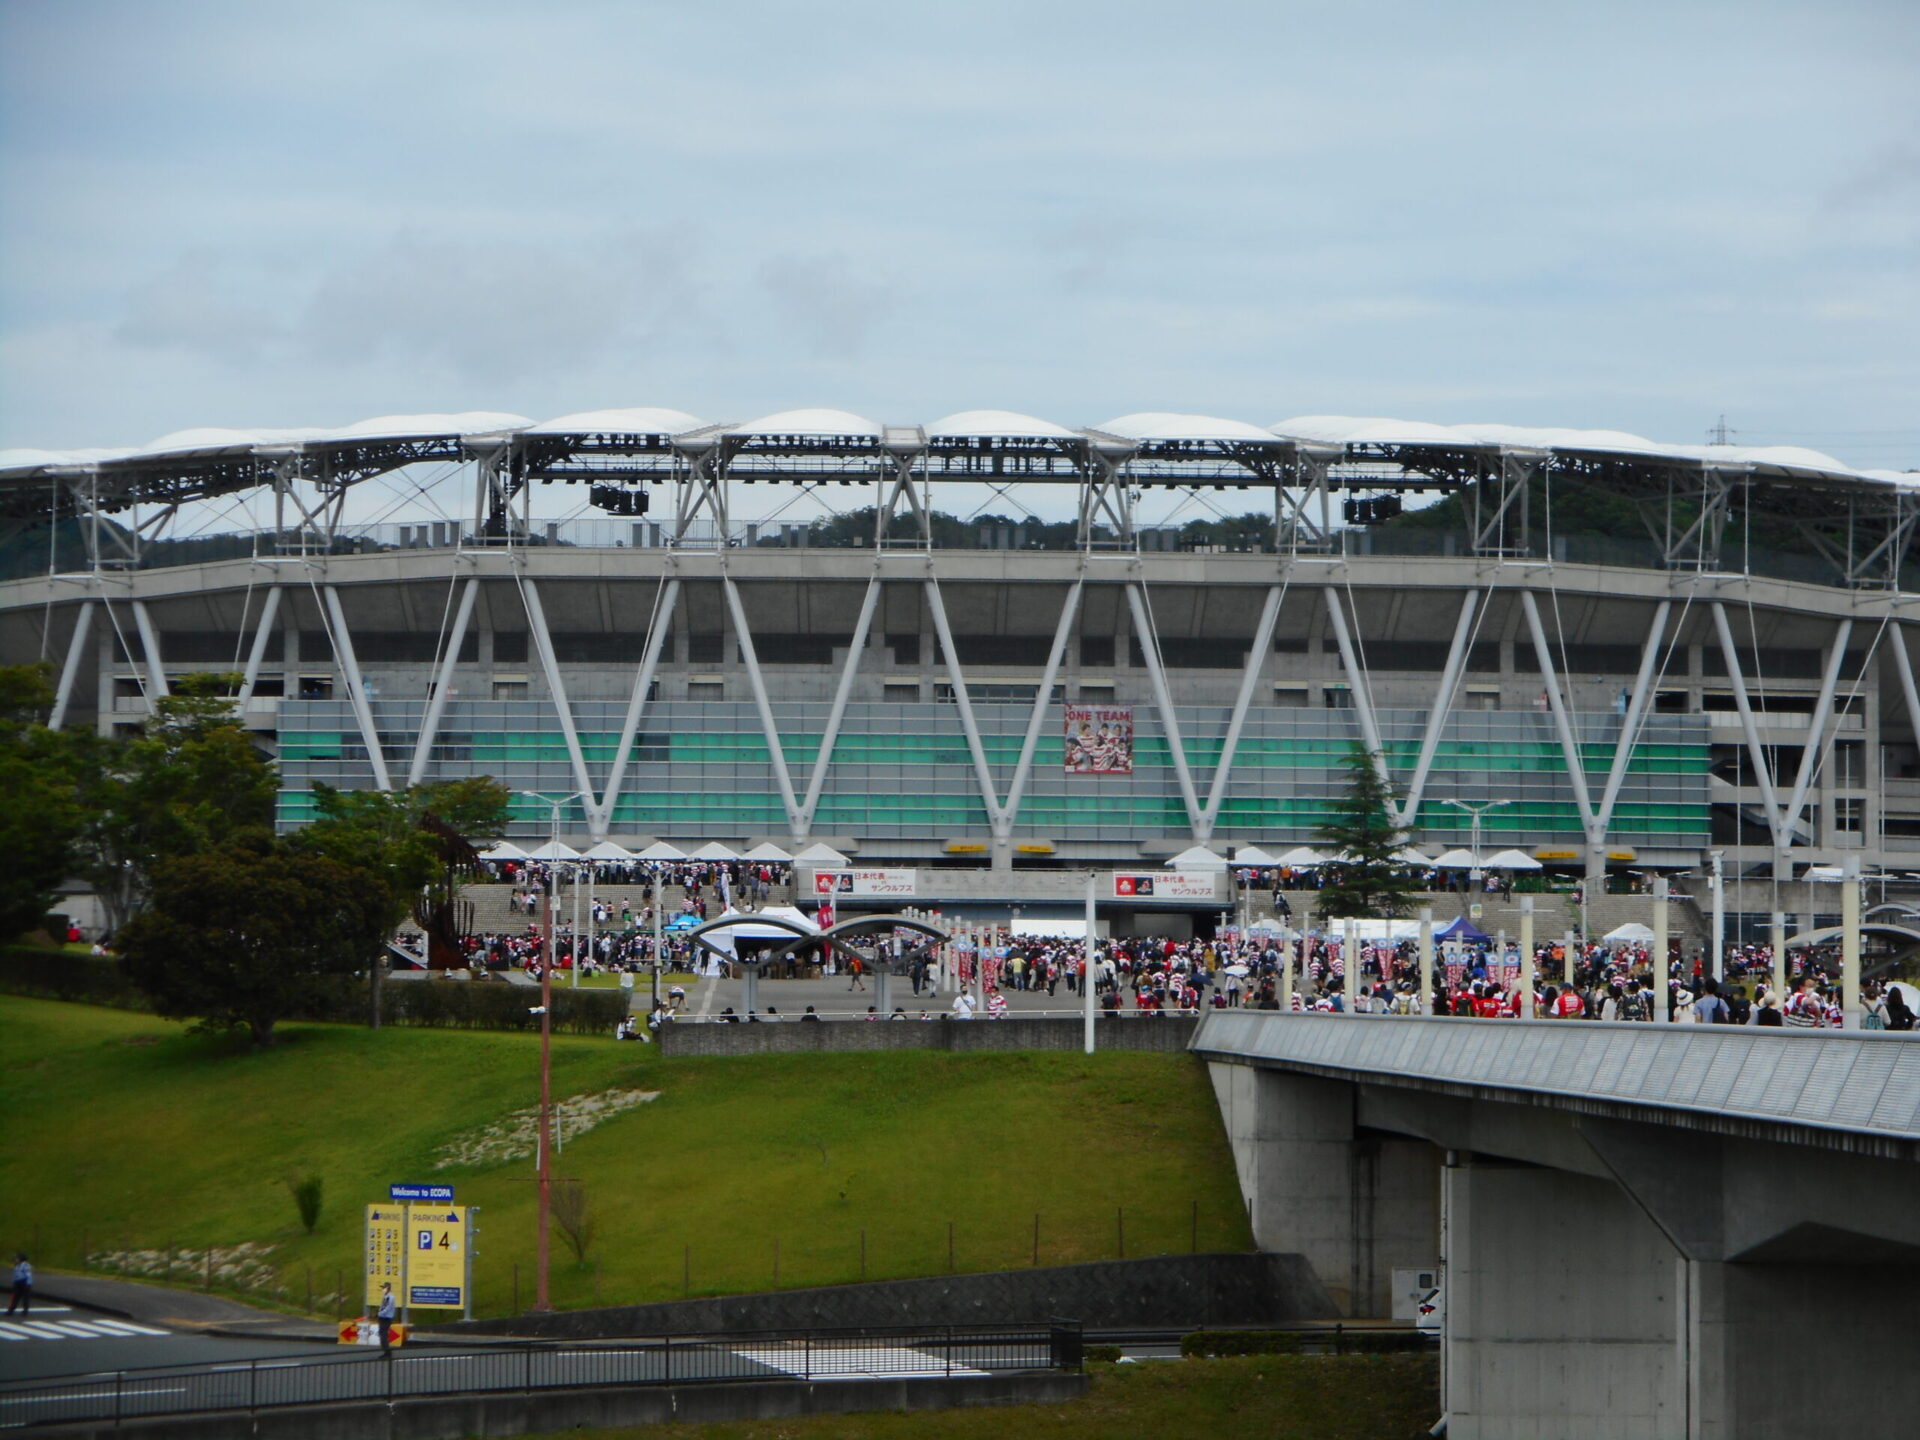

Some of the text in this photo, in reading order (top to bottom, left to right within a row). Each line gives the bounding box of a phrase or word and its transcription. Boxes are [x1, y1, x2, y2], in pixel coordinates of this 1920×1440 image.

[1068, 711, 1130, 721] ONE TEAM
[854, 872, 886, 880] 日本代表
[1154, 875, 1185, 883] 日本代表
[391, 1187, 451, 1198] Welcome to ECOPA
[412, 1214, 446, 1223] PARKING
[420, 1231, 450, 1250] P 4
